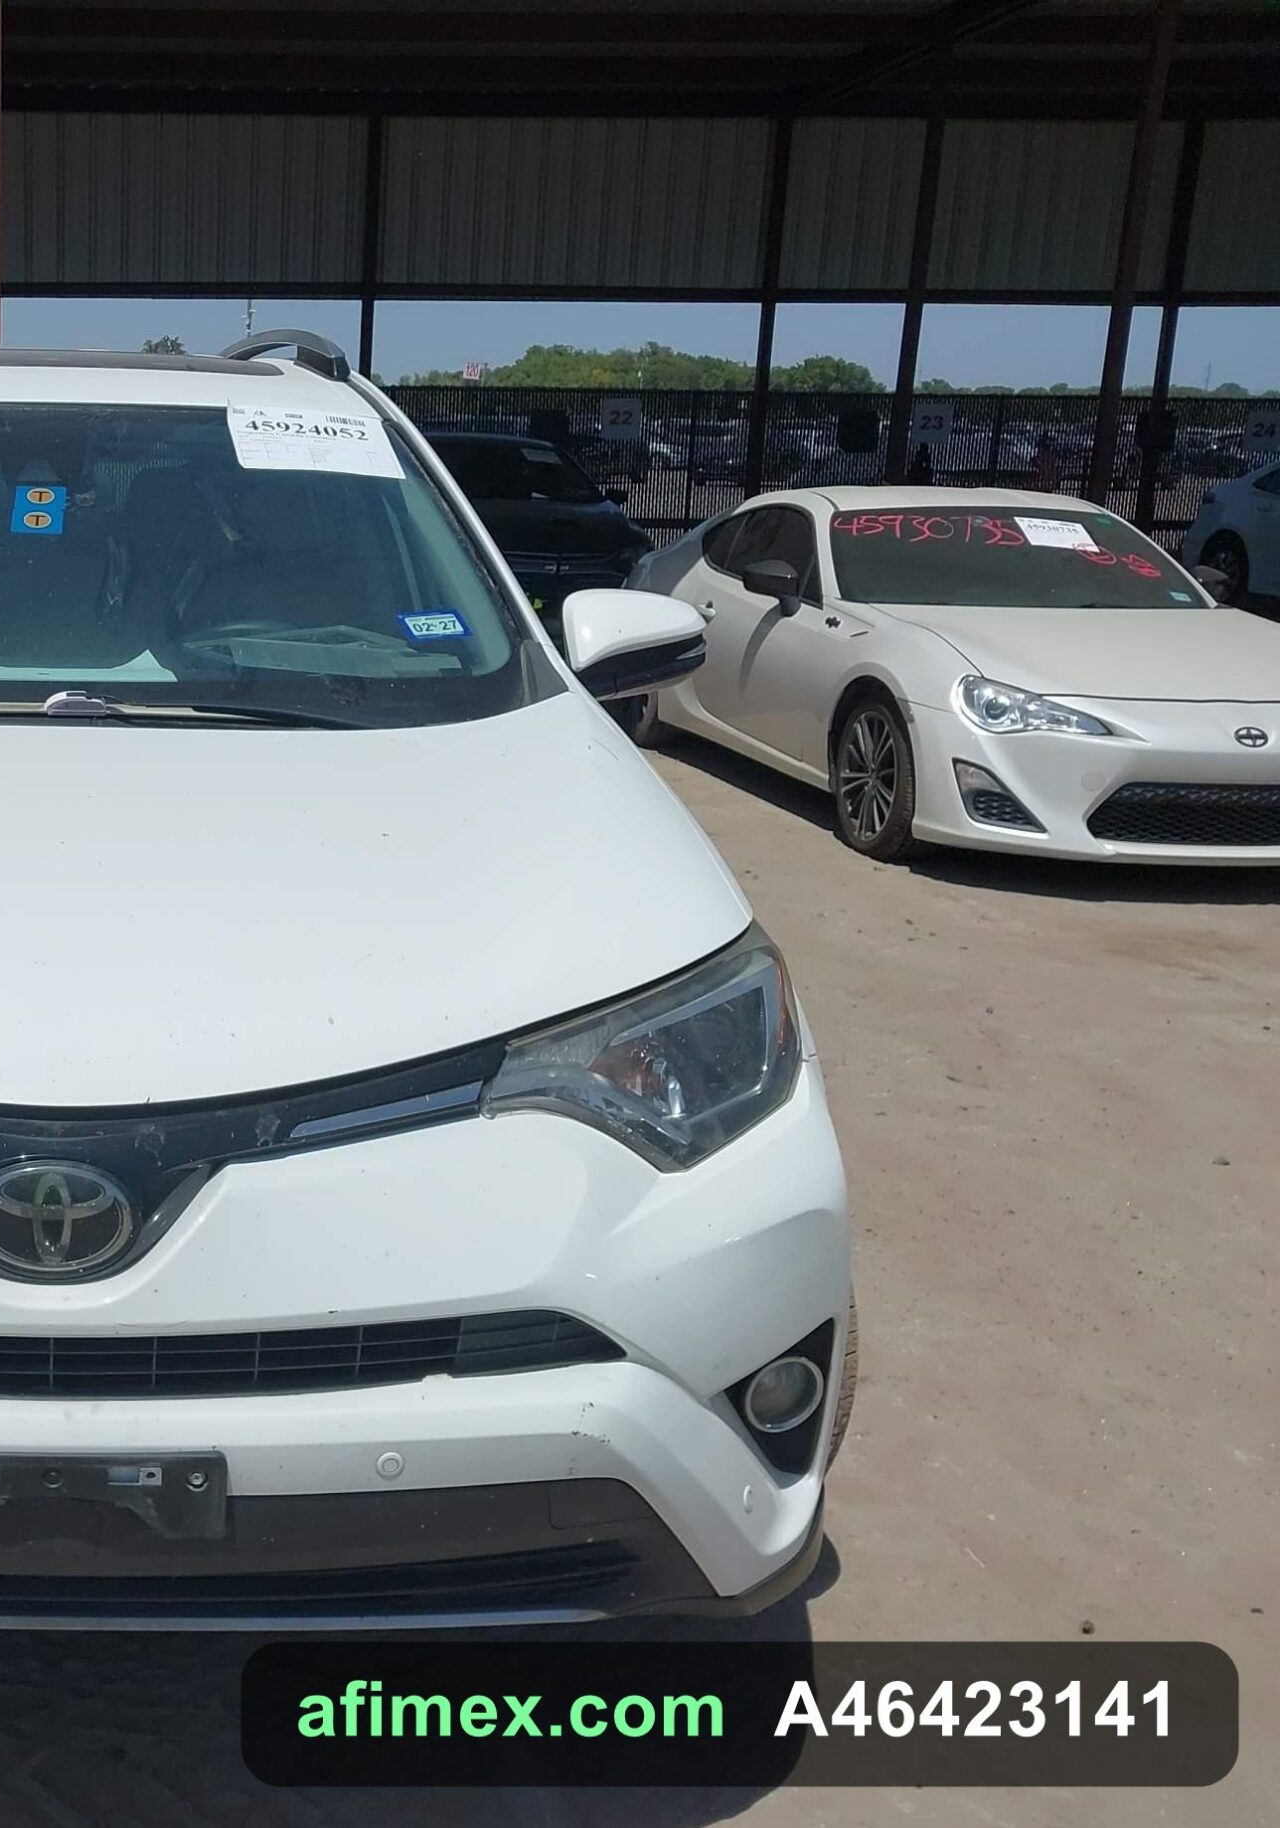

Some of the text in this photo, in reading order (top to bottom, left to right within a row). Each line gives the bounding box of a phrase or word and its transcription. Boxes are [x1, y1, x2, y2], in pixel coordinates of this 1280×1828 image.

[609, 411, 633, 425] 22
[920, 416, 943, 430] 23
[245, 419, 369, 441] 45924052
[1252, 423, 1276, 437] 24
[412, 620, 457, 633] 02 27
